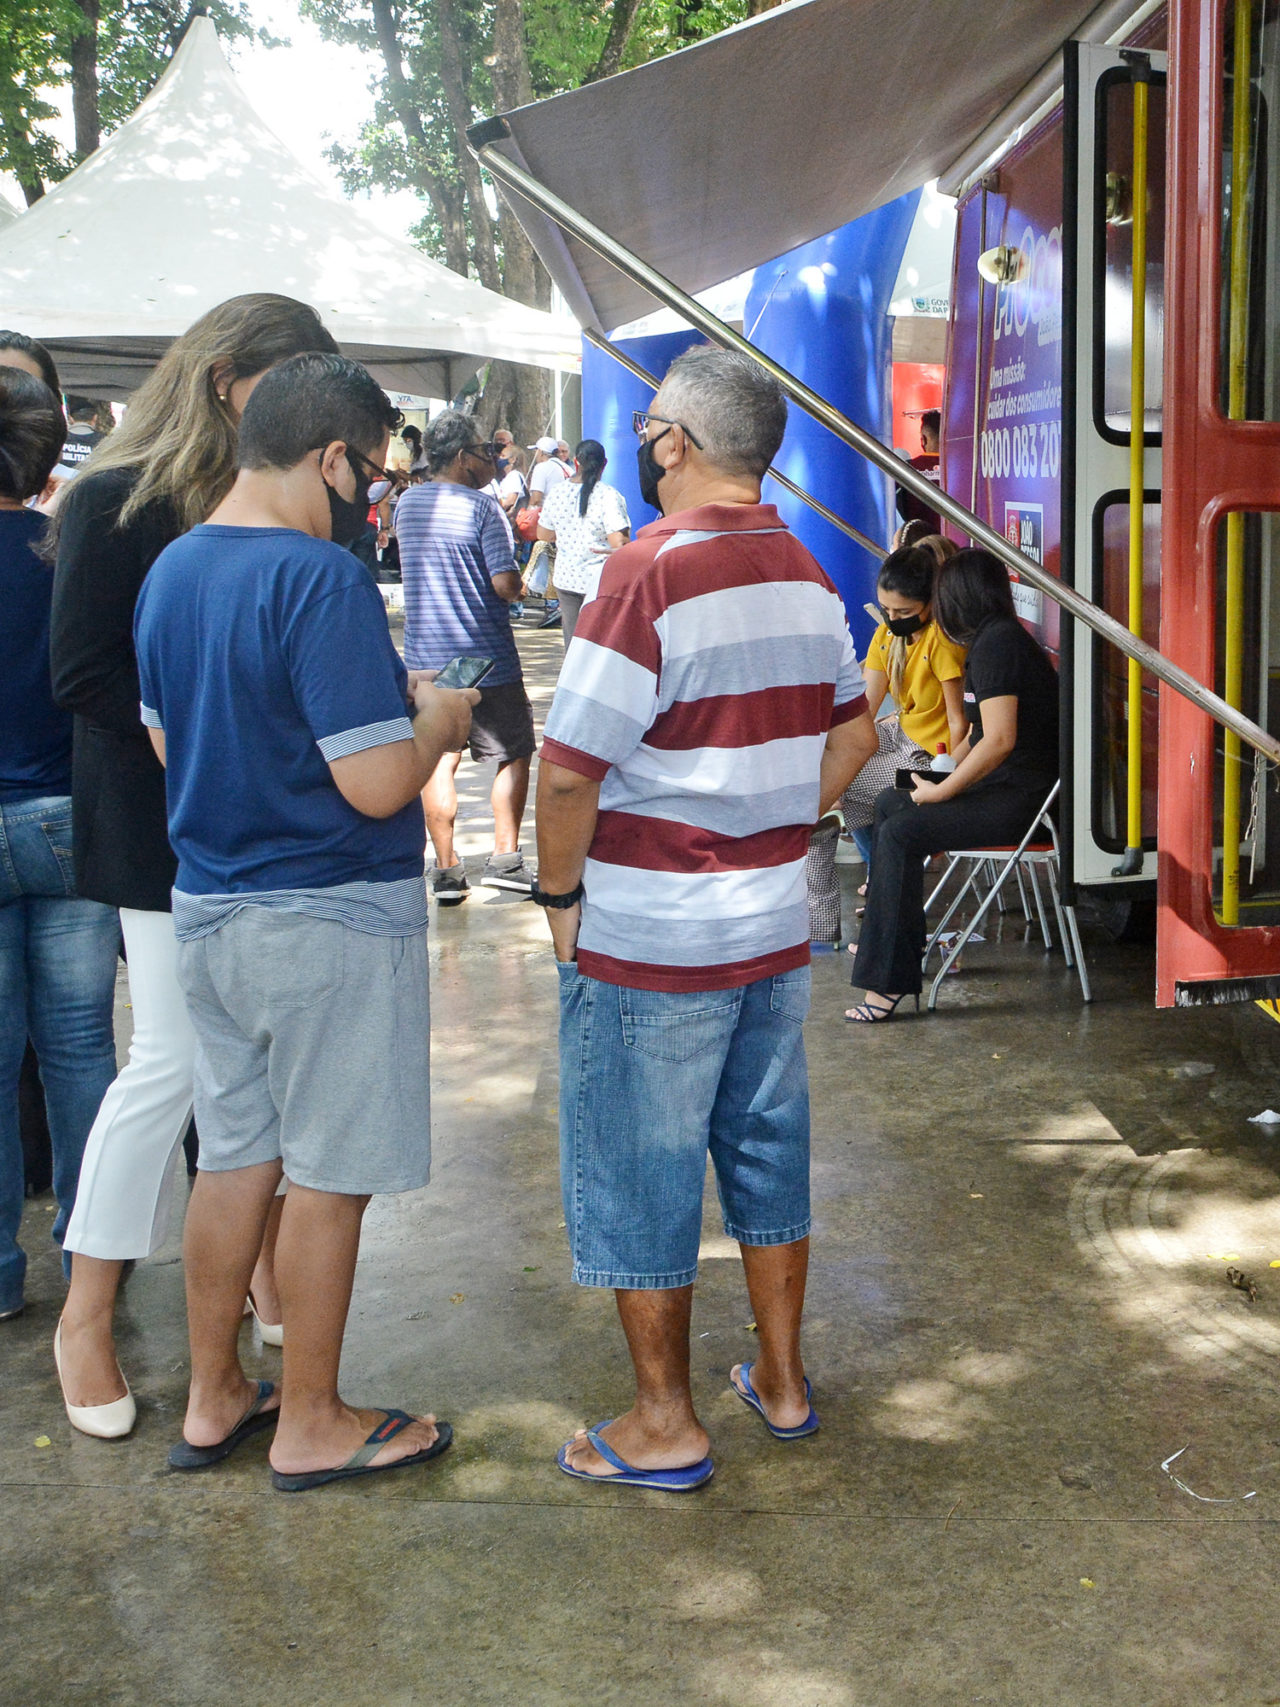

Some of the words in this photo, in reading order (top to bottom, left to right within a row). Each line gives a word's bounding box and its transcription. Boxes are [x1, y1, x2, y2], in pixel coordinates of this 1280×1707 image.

[1017, 380, 1061, 415] consumidore
[62, 443, 92, 454] POLÍCIA
[981, 428, 1010, 479] 0800
[1012, 425, 1037, 478] 083
[1040, 420, 1061, 478] 20
